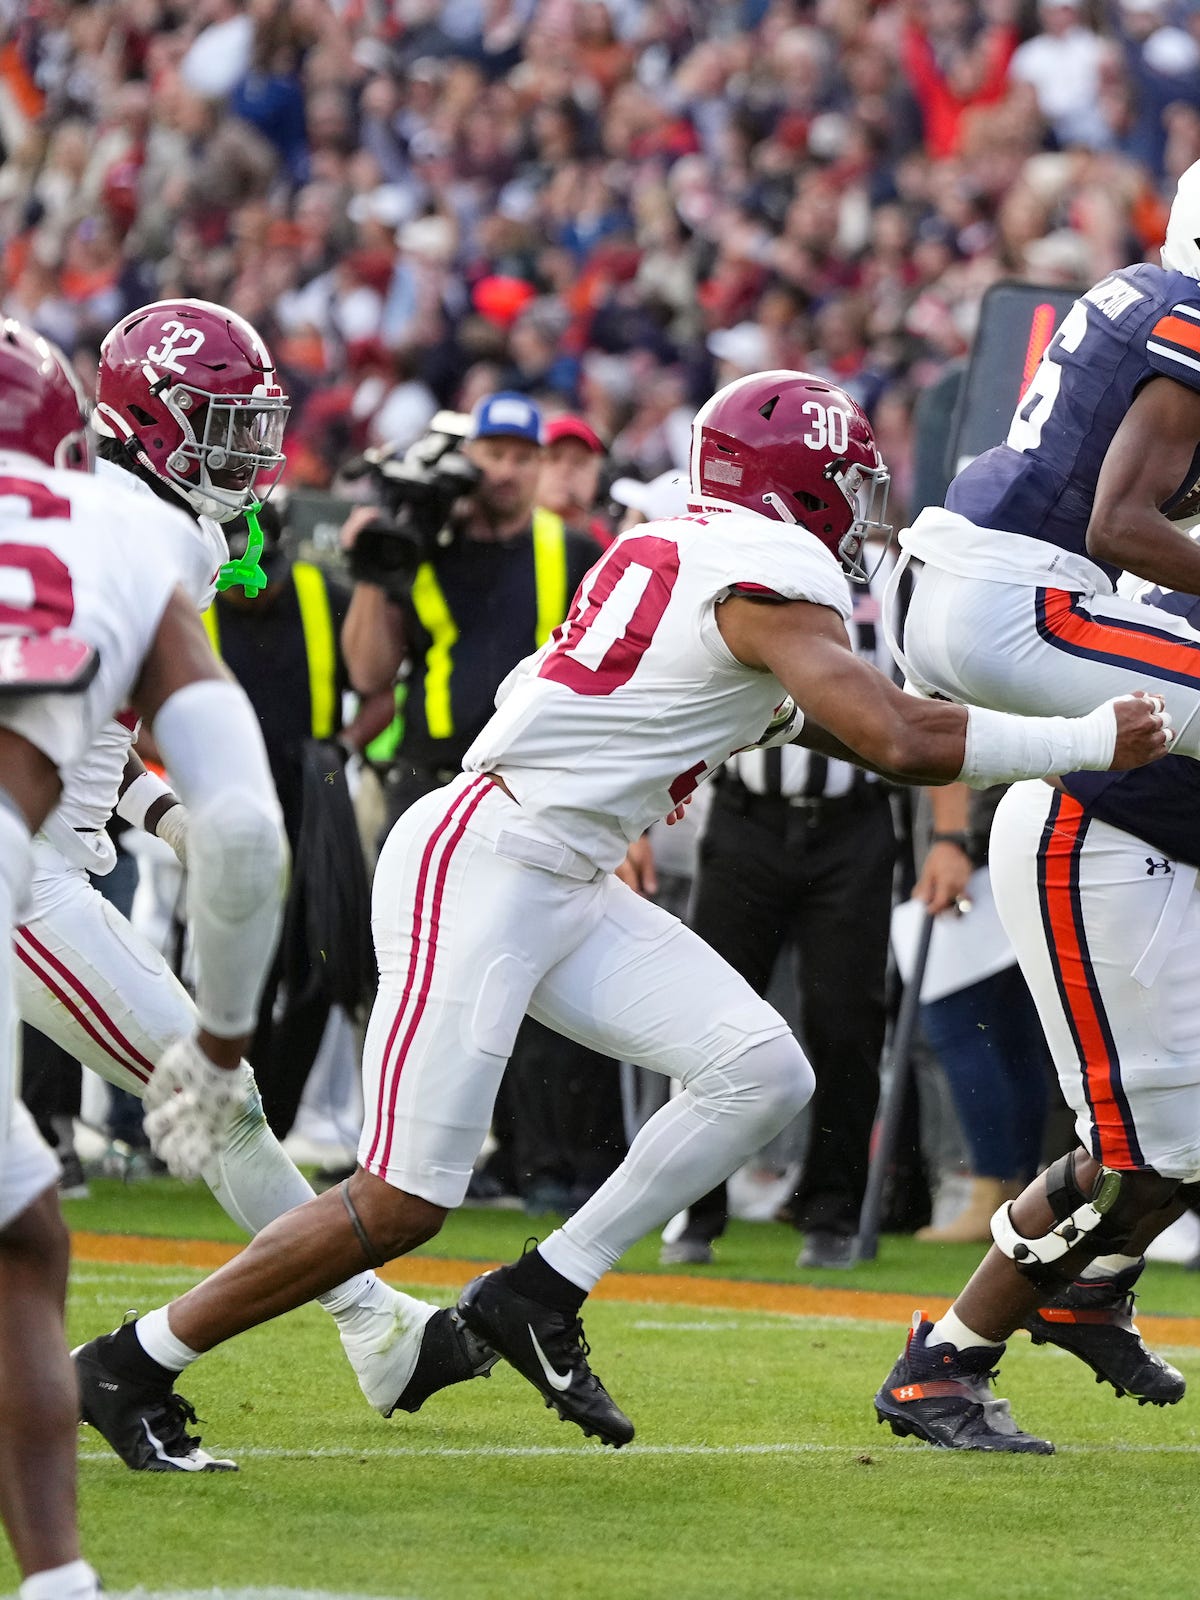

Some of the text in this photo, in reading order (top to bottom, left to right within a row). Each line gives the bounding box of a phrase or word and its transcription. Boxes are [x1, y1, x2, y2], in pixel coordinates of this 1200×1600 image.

[147, 320, 205, 375] 32
[1006, 300, 1088, 453] 6
[800, 400, 849, 455] 30
[537, 535, 681, 695] 0
